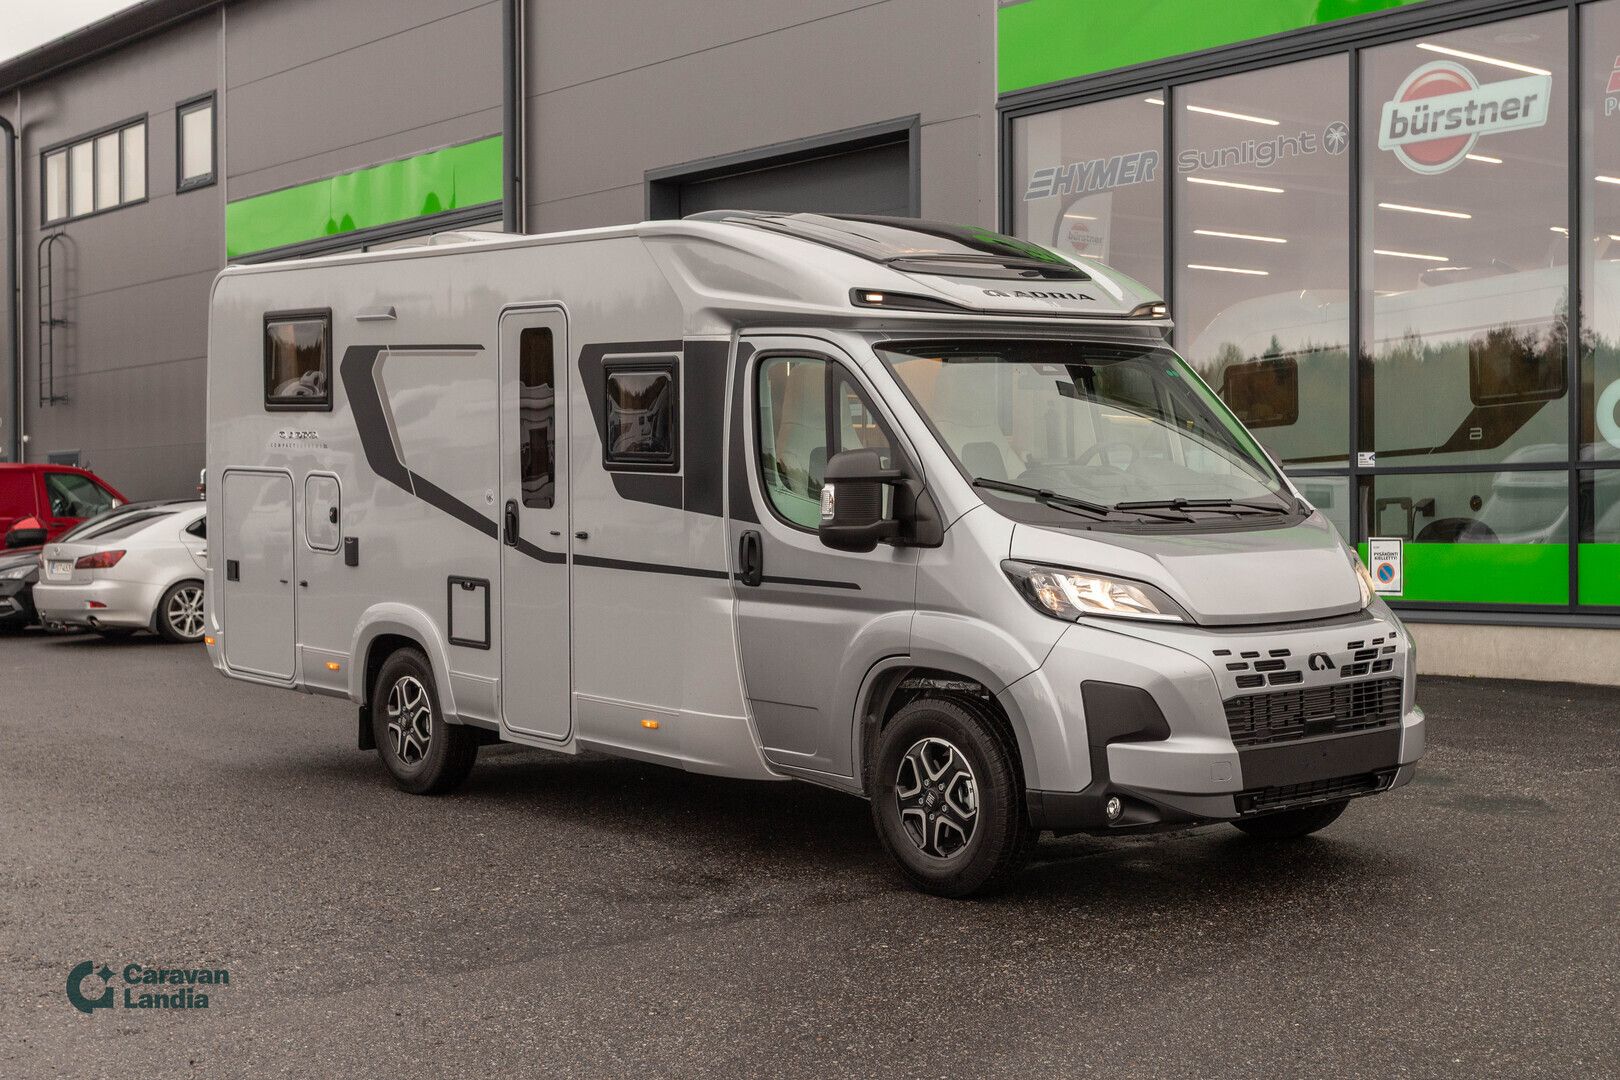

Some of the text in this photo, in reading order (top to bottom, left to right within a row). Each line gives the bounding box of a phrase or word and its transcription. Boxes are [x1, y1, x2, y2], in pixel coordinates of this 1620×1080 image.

[1388, 93, 1538, 139] bürstner
[1050, 150, 1159, 196] HYMER
[1177, 131, 1316, 173] Sunlight
[1014, 290, 1097, 301] ADRIA
